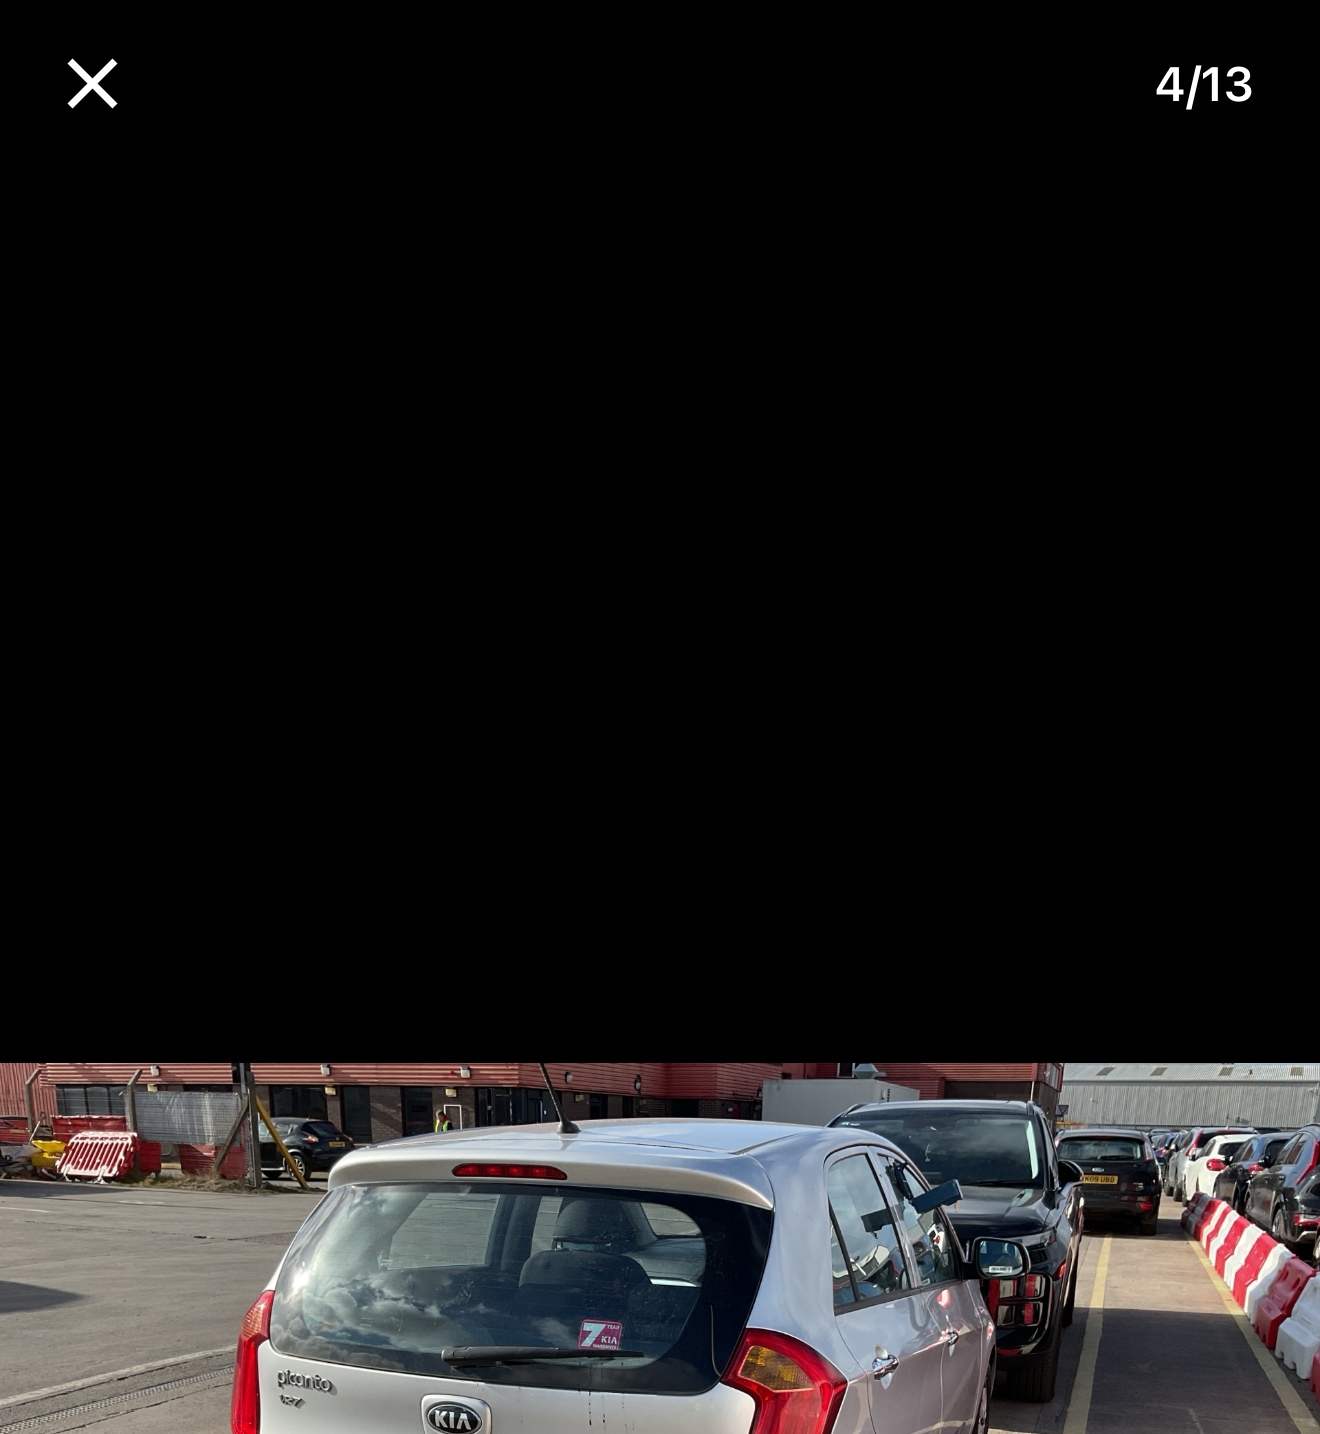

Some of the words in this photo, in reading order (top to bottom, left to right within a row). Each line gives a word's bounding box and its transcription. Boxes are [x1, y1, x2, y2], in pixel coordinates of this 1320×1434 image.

[580, 1322, 607, 1347] 7
[601, 1335, 617, 1345] KIA
[277, 1369, 333, 1391] picanto
[434, 1409, 472, 1431] KIA
